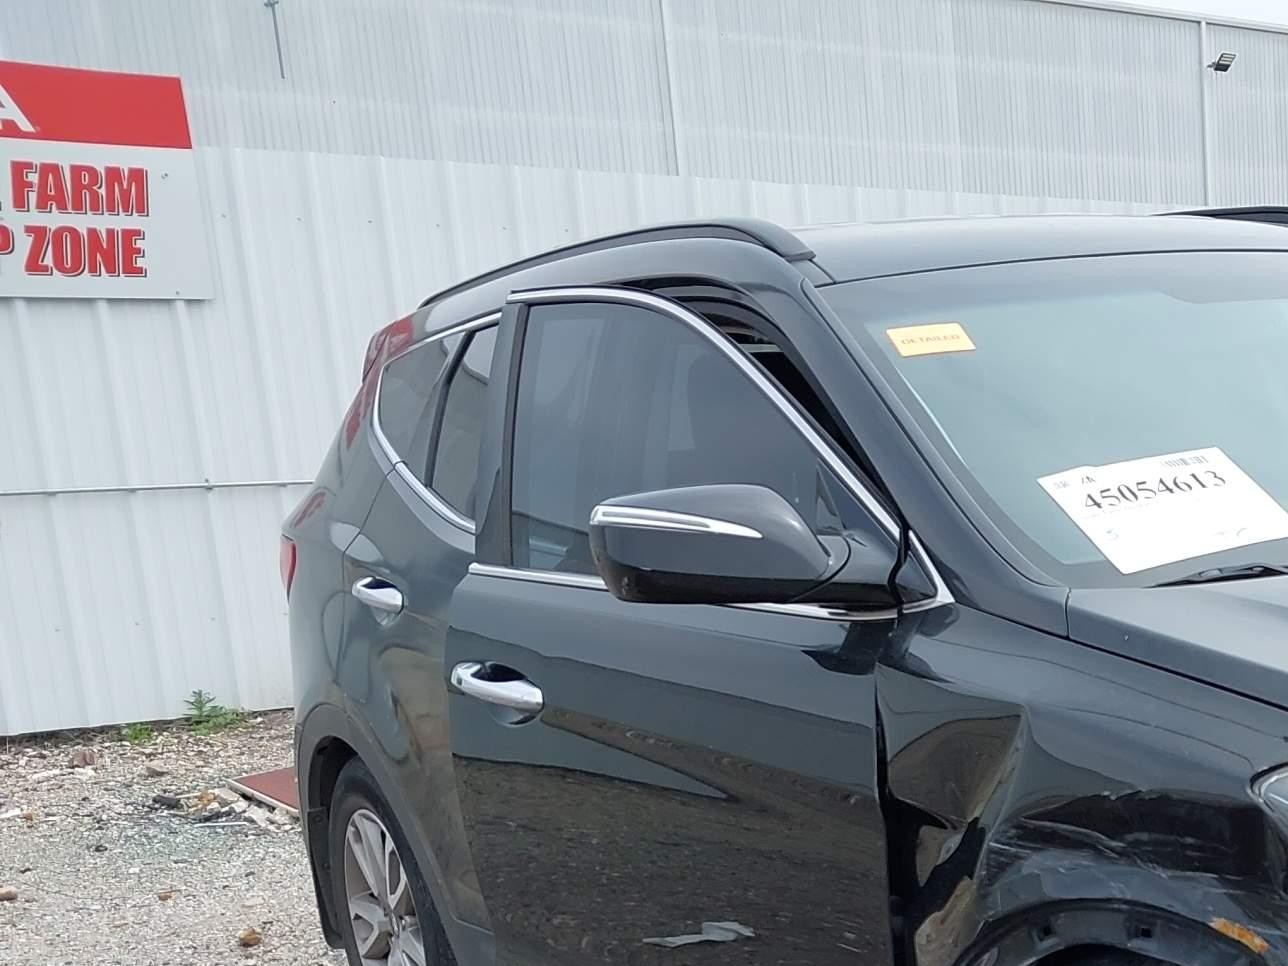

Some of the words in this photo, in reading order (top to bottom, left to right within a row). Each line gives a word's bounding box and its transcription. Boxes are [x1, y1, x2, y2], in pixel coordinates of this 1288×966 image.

[10, 160, 149, 216] FARM
[23, 225, 147, 278] ZONE
[1084, 470, 1226, 510] 45054613
